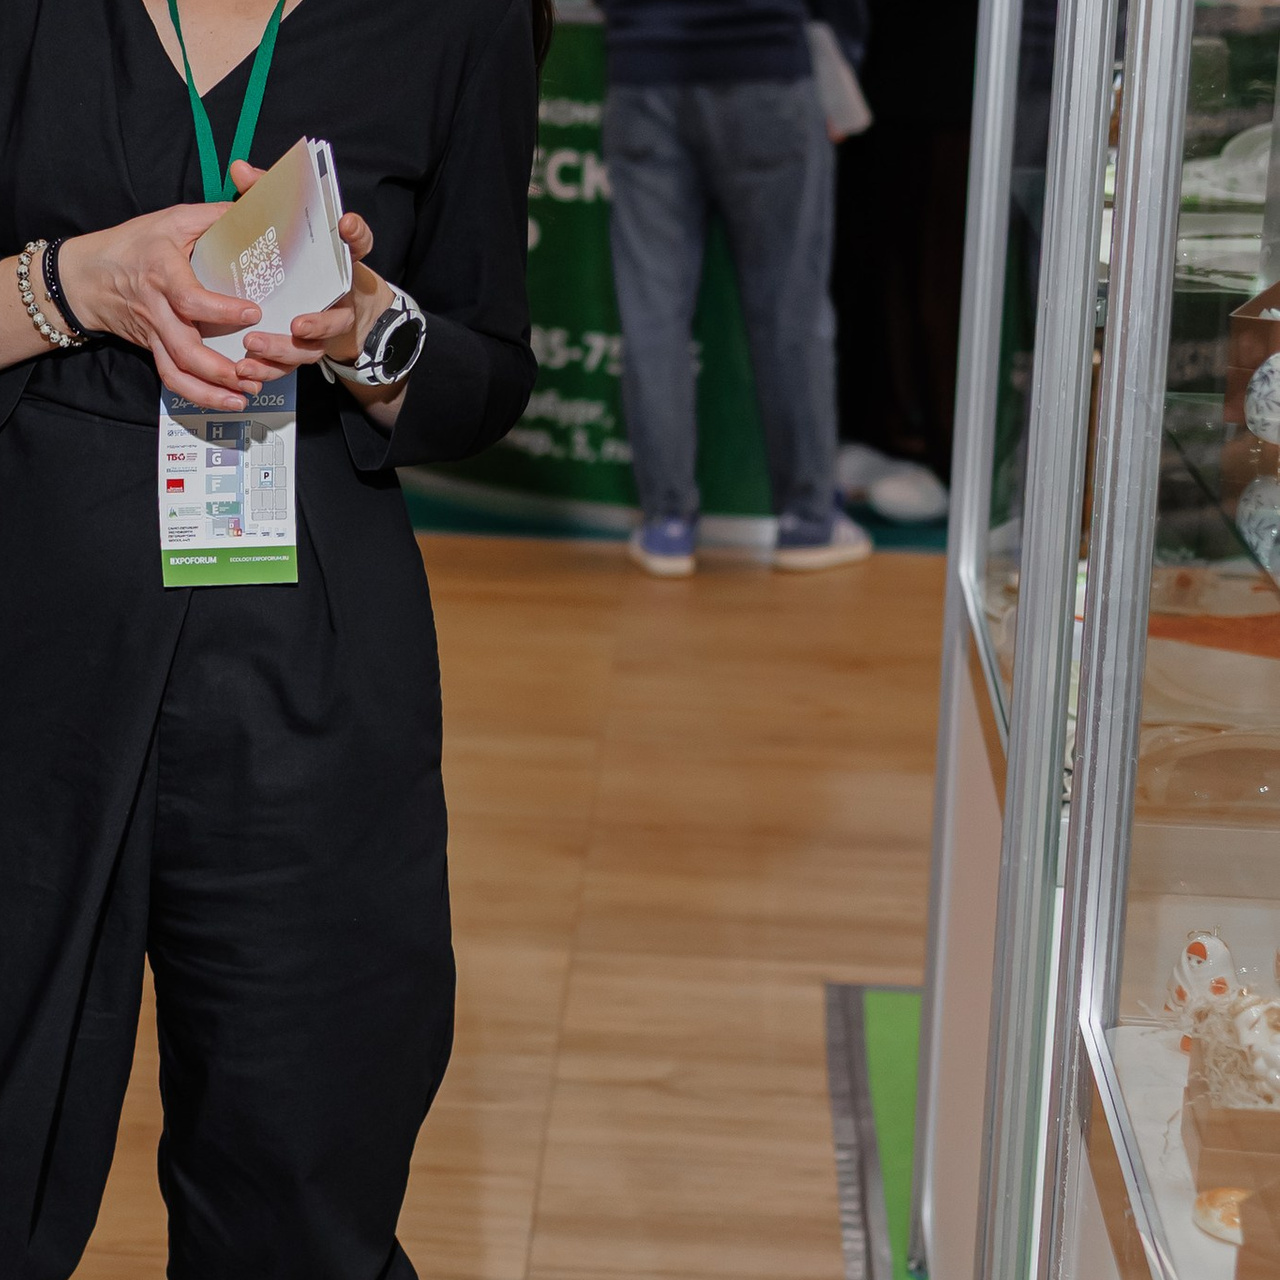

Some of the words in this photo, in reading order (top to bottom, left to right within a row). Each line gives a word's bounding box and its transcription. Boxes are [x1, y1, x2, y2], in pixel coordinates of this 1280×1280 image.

[252, 394, 285, 407] 2026
[213, 426, 223, 439] H
[211, 452, 222, 465] G
[263, 471, 270, 479] P
[211, 479, 221, 492] F
[212, 504, 219, 515] E
[170, 555, 217, 566] EXPOFORUM
